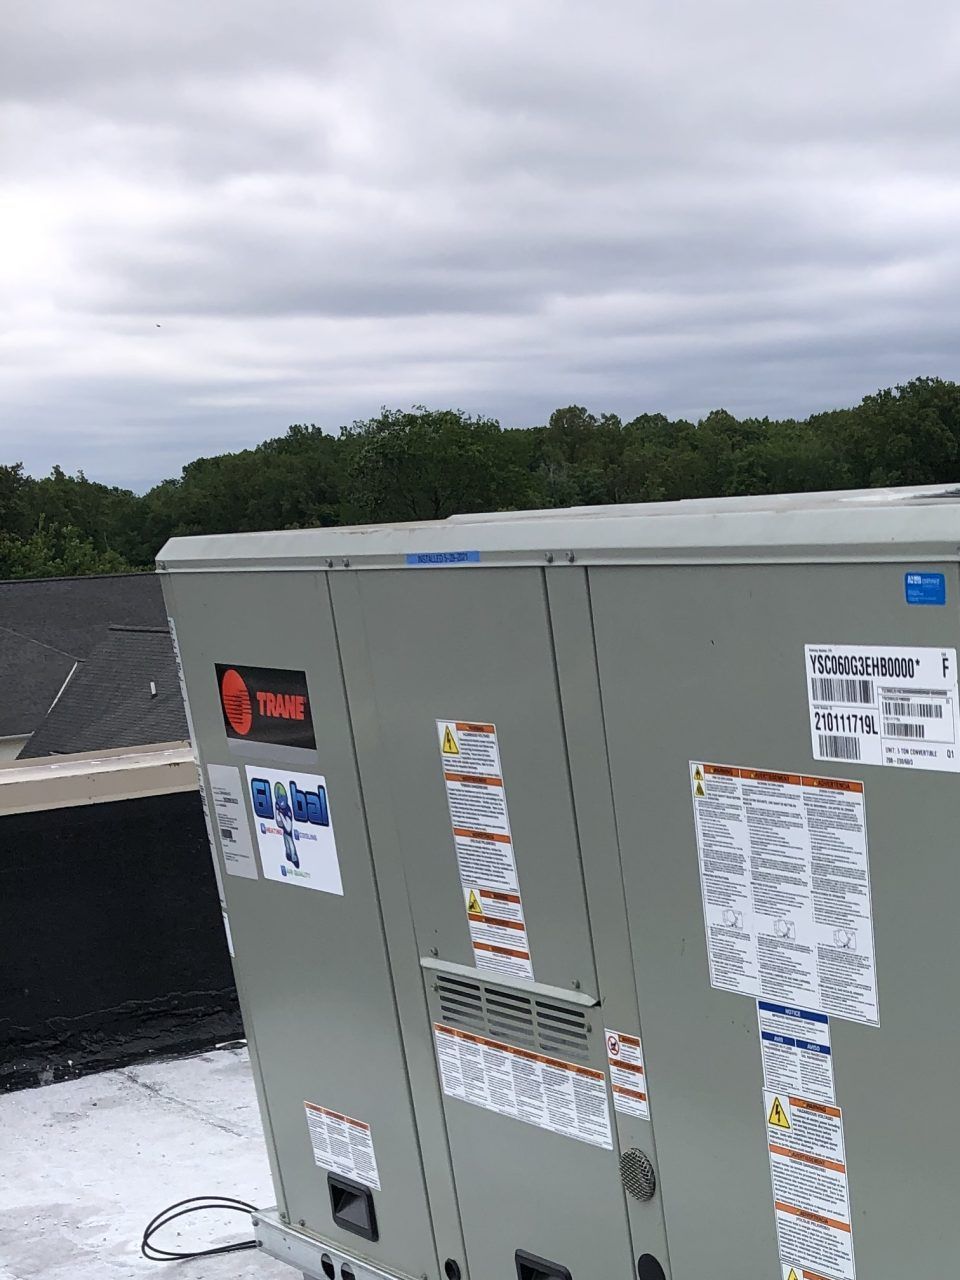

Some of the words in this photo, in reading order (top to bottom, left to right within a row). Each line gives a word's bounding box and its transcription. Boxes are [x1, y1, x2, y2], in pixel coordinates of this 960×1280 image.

[942, 657, 949, 679] F
[256, 691, 305, 720] TRANE
[814, 711, 879, 735] 210111719L
[785, 1008, 801, 1018] NOTICE
